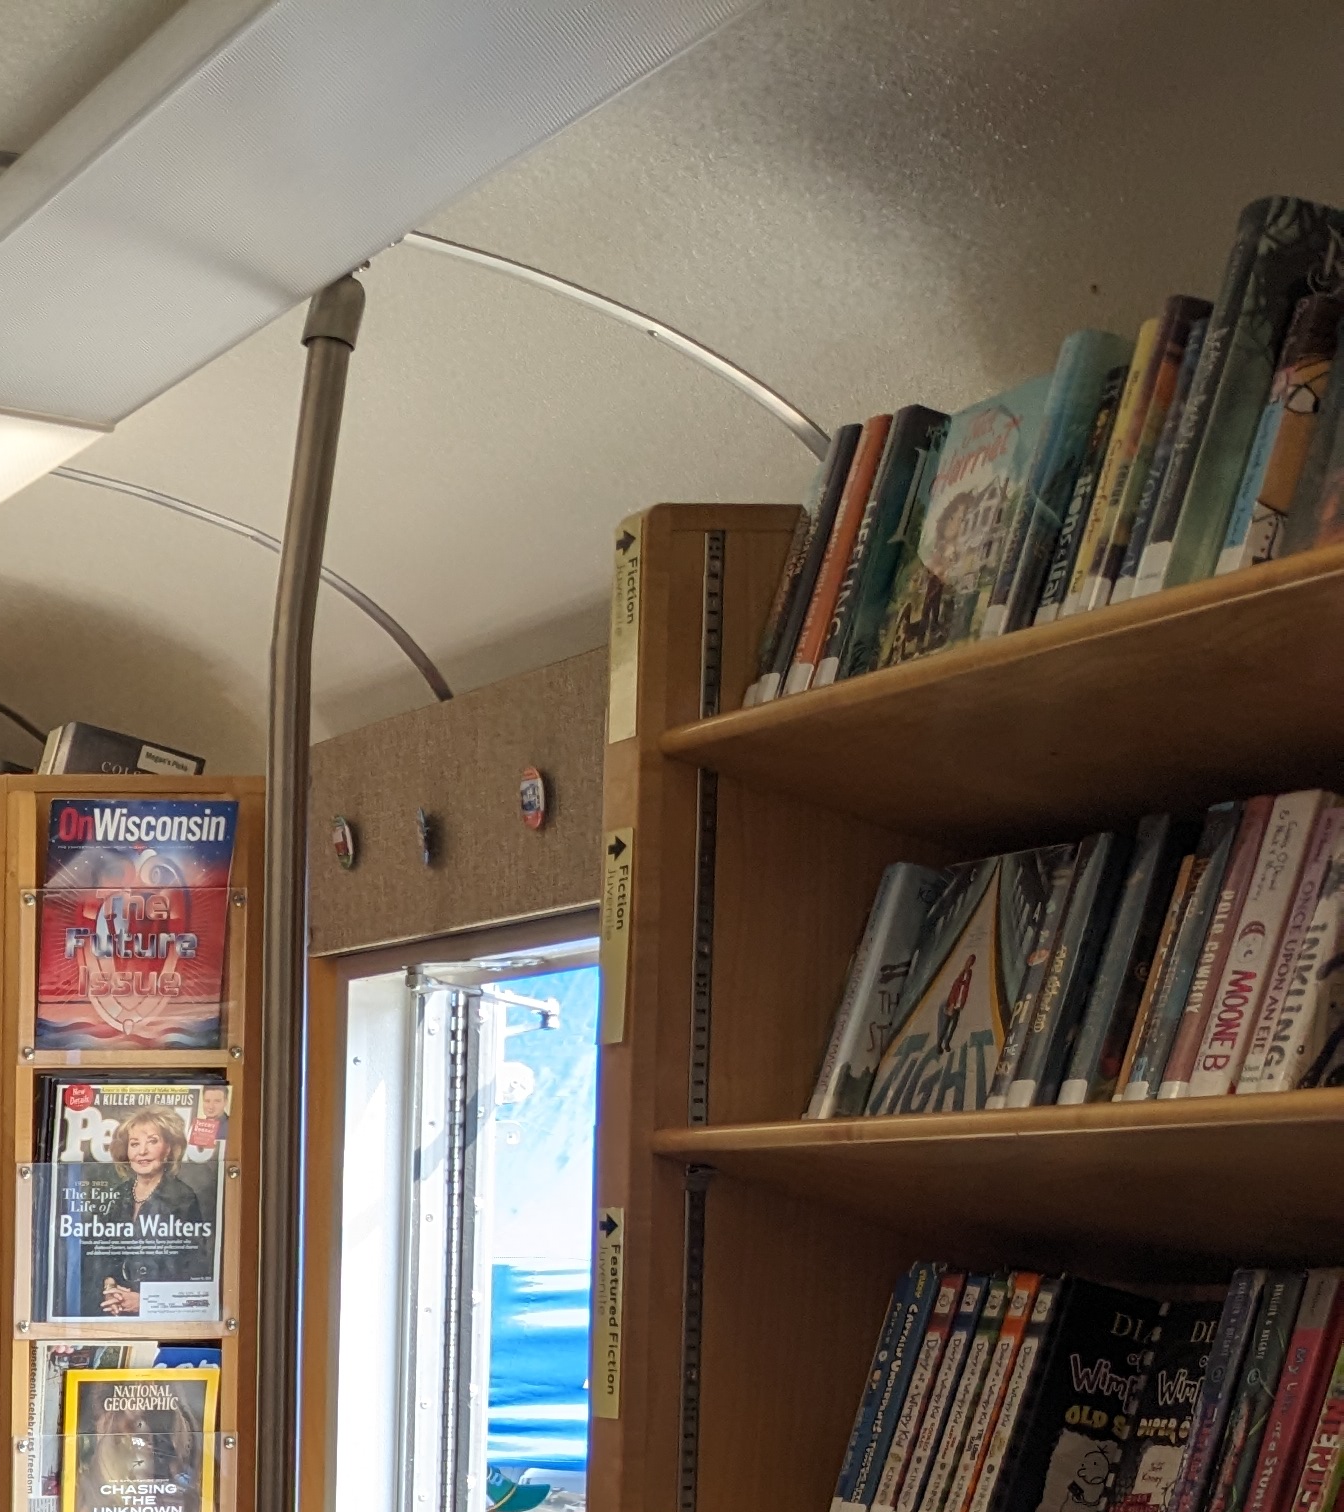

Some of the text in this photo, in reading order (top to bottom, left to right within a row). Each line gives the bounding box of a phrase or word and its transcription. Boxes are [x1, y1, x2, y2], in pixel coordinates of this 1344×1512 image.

[625, 556, 638, 623] Fiction
[96, 889, 170, 921] The
[615, 863, 629, 931] Fiction
[65, 927, 199, 959] Future
[1184, 938, 1219, 1015] COWBOY
[1270, 938, 1298, 992] UPON
[78, 966, 182, 997] Issue
[1213, 969, 1257, 1050] MOONE
[1260, 994, 1280, 1023] AN
[94, 1093, 194, 1106] A KILLER ON CAMPUS
[63, 1188, 120, 1200] The Epic
[71, 1200, 112, 1214] Life of
[60, 1214, 211, 1237] Barbara Walters
[606, 1243, 621, 1394] Featured Fiction
[918, 1337, 937, 1371] Diary
[104, 1397, 179, 1411] GEOGRAPHIC
[113, 1385, 172, 1397] NATIONAL
[899, 1390, 920, 1429] Wimpy
[1065, 1404, 1109, 1429] OLD
[894, 1429, 909, 1448] Kid
[27, 1454, 35, 1494] freedom
[100, 1484, 177, 1494] CHASING
[122, 1495, 156, 1505] THE
